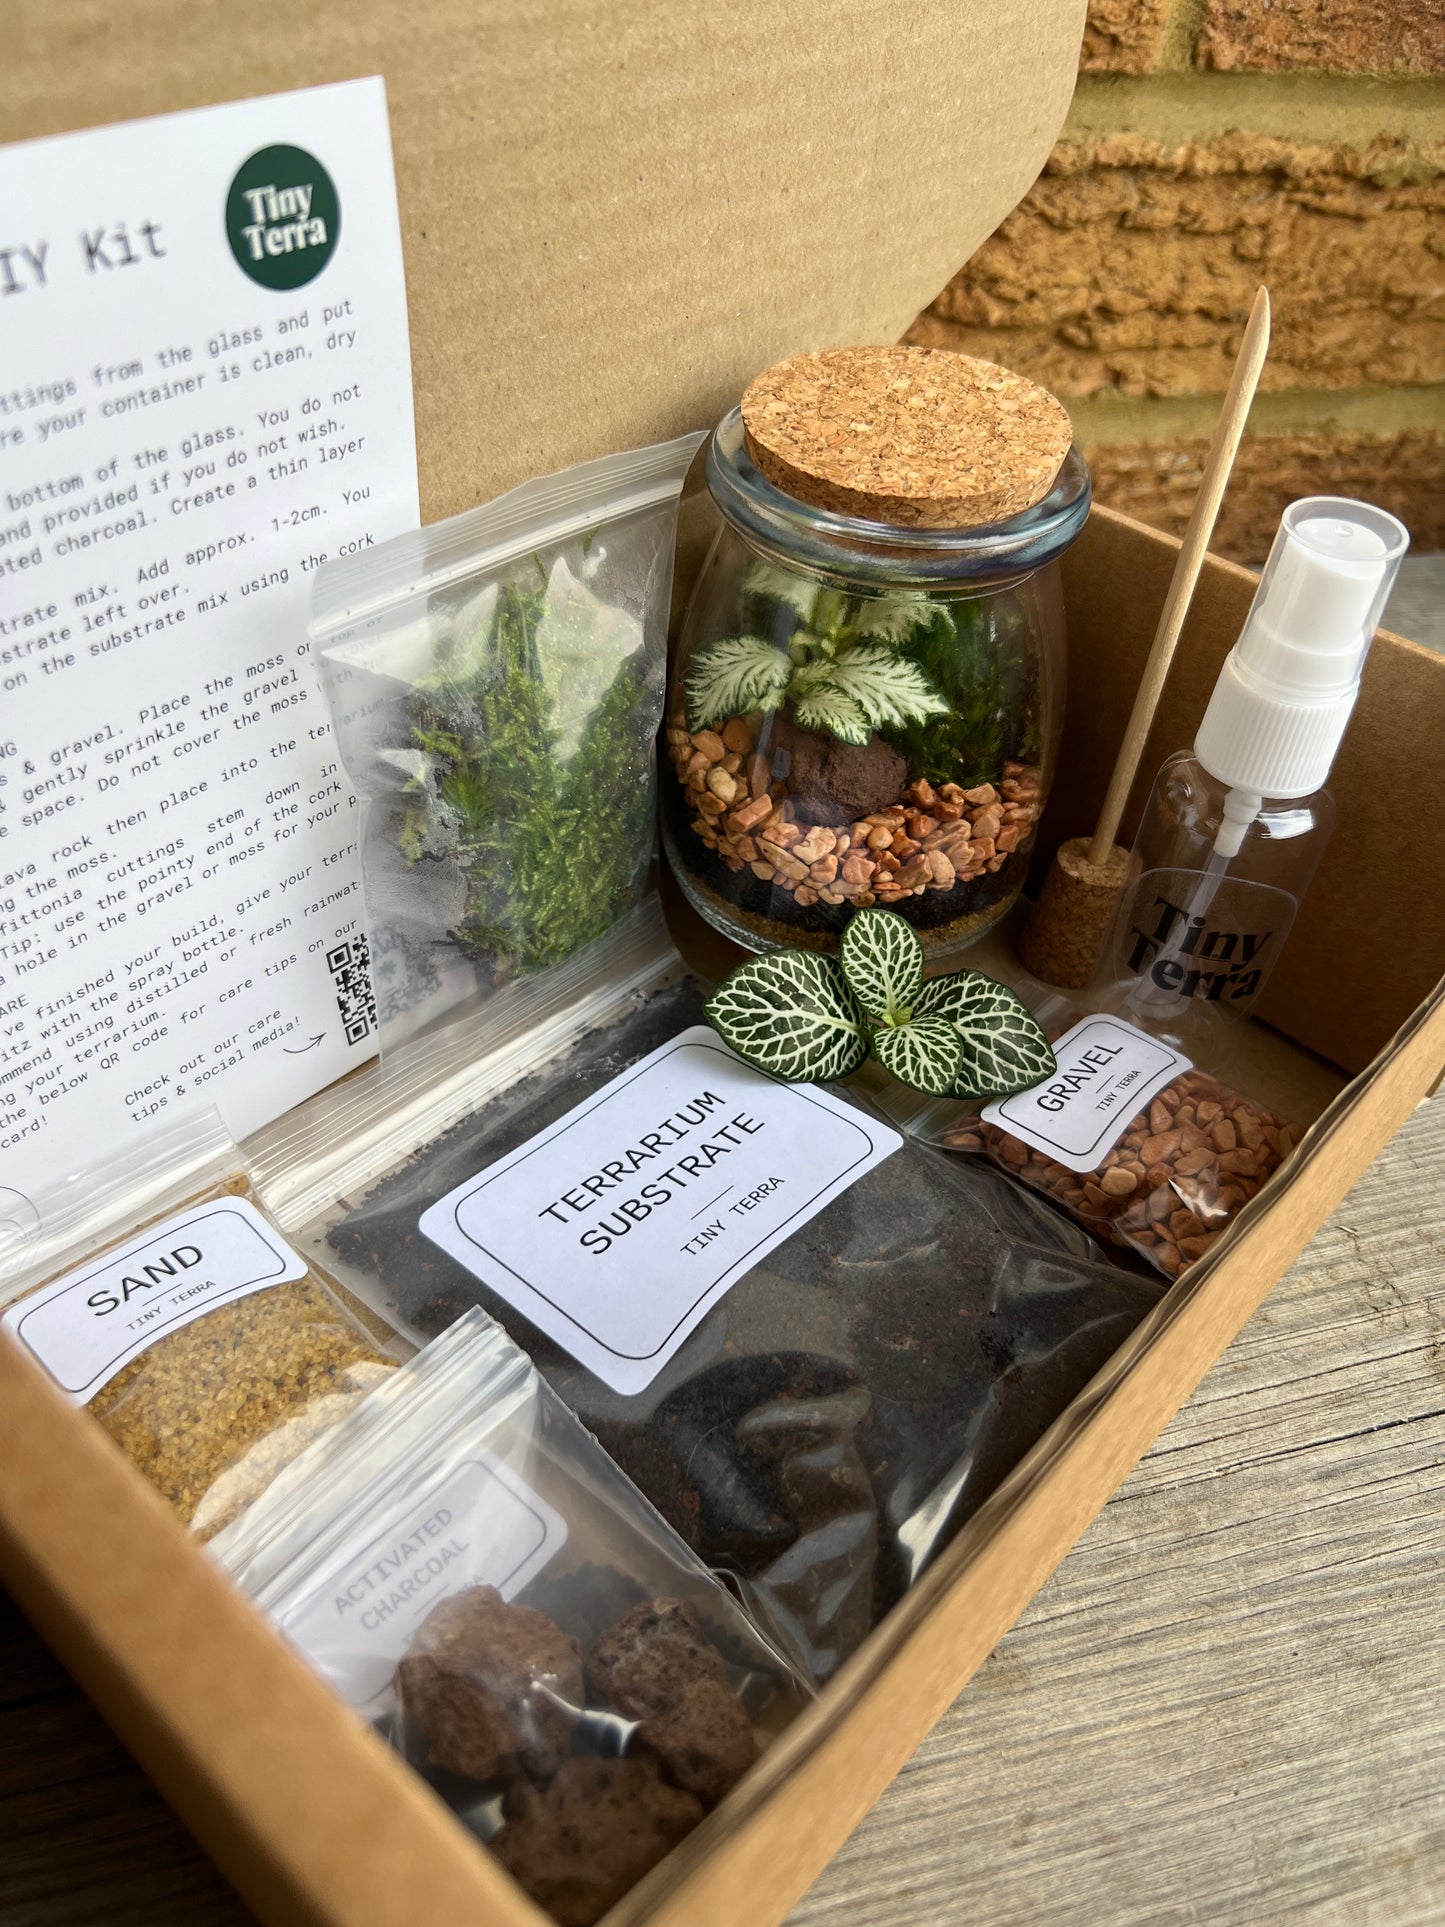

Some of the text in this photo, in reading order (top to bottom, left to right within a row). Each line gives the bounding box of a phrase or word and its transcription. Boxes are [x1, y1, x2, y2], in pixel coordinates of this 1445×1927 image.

[81, 221, 167, 273] Kit
[241, 216, 327, 260] Terra
[242, 183, 313, 223] Tiny
[38, 409, 86, 441] your
[102, 375, 206, 417] container
[219, 365, 241, 382] is
[253, 345, 312, 373] clean,
[327, 331, 356, 349] dry
[94, 361, 143, 386] from
[158, 346, 193, 368] the
[208, 328, 263, 358] glass
[278, 311, 309, 334] and
[323, 301, 353, 325] put
[8, 384, 361, 511] bottom of the glass. You do not
[44, 484, 138, 533] provided
[151, 473, 170, 494] if
[183, 461, 216, 487] you
[227, 451, 247, 468] do
[258, 437, 288, 457] not
[298, 419, 345, 443] wish.
[56, 511, 157, 556] charcoal.
[171, 484, 235, 515] Create
[248, 476, 257, 488] a
[269, 458, 308, 480] thin
[320, 437, 365, 464] layer
[75, 585, 118, 607] mix.
[138, 559, 169, 584] Add
[186, 532, 255, 566] approx.
[272, 505, 327, 532] 1-2cm.
[343, 487, 370, 505] You
[4, 532, 375, 690] on the substrate mix using the cork
[83, 604, 127, 632] left
[138, 584, 189, 610] over.
[22, 795, 84, 826] space.
[97, 775, 119, 792] Do
[131, 755, 161, 776] not
[173, 728, 220, 757] cover
[233, 711, 261, 730] the
[271, 690, 308, 714] moss
[23, 763, 87, 803] gently
[104, 721, 186, 763] sprinkle
[200, 701, 229, 721] the
[243, 669, 298, 705] gravel
[24, 654, 284, 775] & gravel. Place the moss
[0, 763, 337, 936] fittonia cuttings stem down in
[52, 835, 93, 862] rock
[106, 809, 147, 835] then
[160, 781, 208, 813] place
[221, 758, 258, 782] into
[270, 740, 297, 758] the
[0, 781, 342, 959] Tip: use the pointy end of the cork
[15, 948, 58, 975] hole
[68, 932, 88, 949] in
[98, 912, 127, 932] the
[137, 876, 194, 915] gravel
[202, 864, 219, 879] or
[229, 842, 265, 866] moss
[274, 823, 298, 842] for
[307, 803, 339, 829] your
[26, 853, 117, 898] the moss.
[0, 880, 360, 1086] mmend using distilled or fresh rainwat
[36, 969, 115, 1019] finished
[125, 946, 161, 975] your
[172, 915, 224, 947] build,
[236, 888, 271, 915] give
[280, 866, 312, 892] your
[40, 1012, 81, 1039] with
[90, 991, 119, 1012] the
[129, 961, 174, 991] spray
[183, 924, 244, 962] bottle.
[1127, 926, 1262, 1000] Terra
[1154, 896, 1273, 972] Tiny
[0, 919, 357, 1129] the below QR code for care tips on our
[25, 1010, 166, 1095] your terrarium.
[125, 1009, 282, 1106] Check out our care
[131, 1016, 300, 1122] tips & social media!
[1, 1115, 48, 1149] card!
[1036, 1045, 1124, 1112] GRAVEL
[1095, 1069, 1142, 1111] TINY TERRA
[538, 1090, 726, 1224] TERRARIUM
[579, 1112, 765, 1255] SUBSTRATE
[680, 1176, 785, 1256] TINY TERRA
[87, 1245, 203, 1317] SAND
[126, 1280, 216, 1331] TINY TERRA
[334, 1508, 453, 1615] ACTIVATED
[360, 1538, 470, 1630] CHARCOAL
